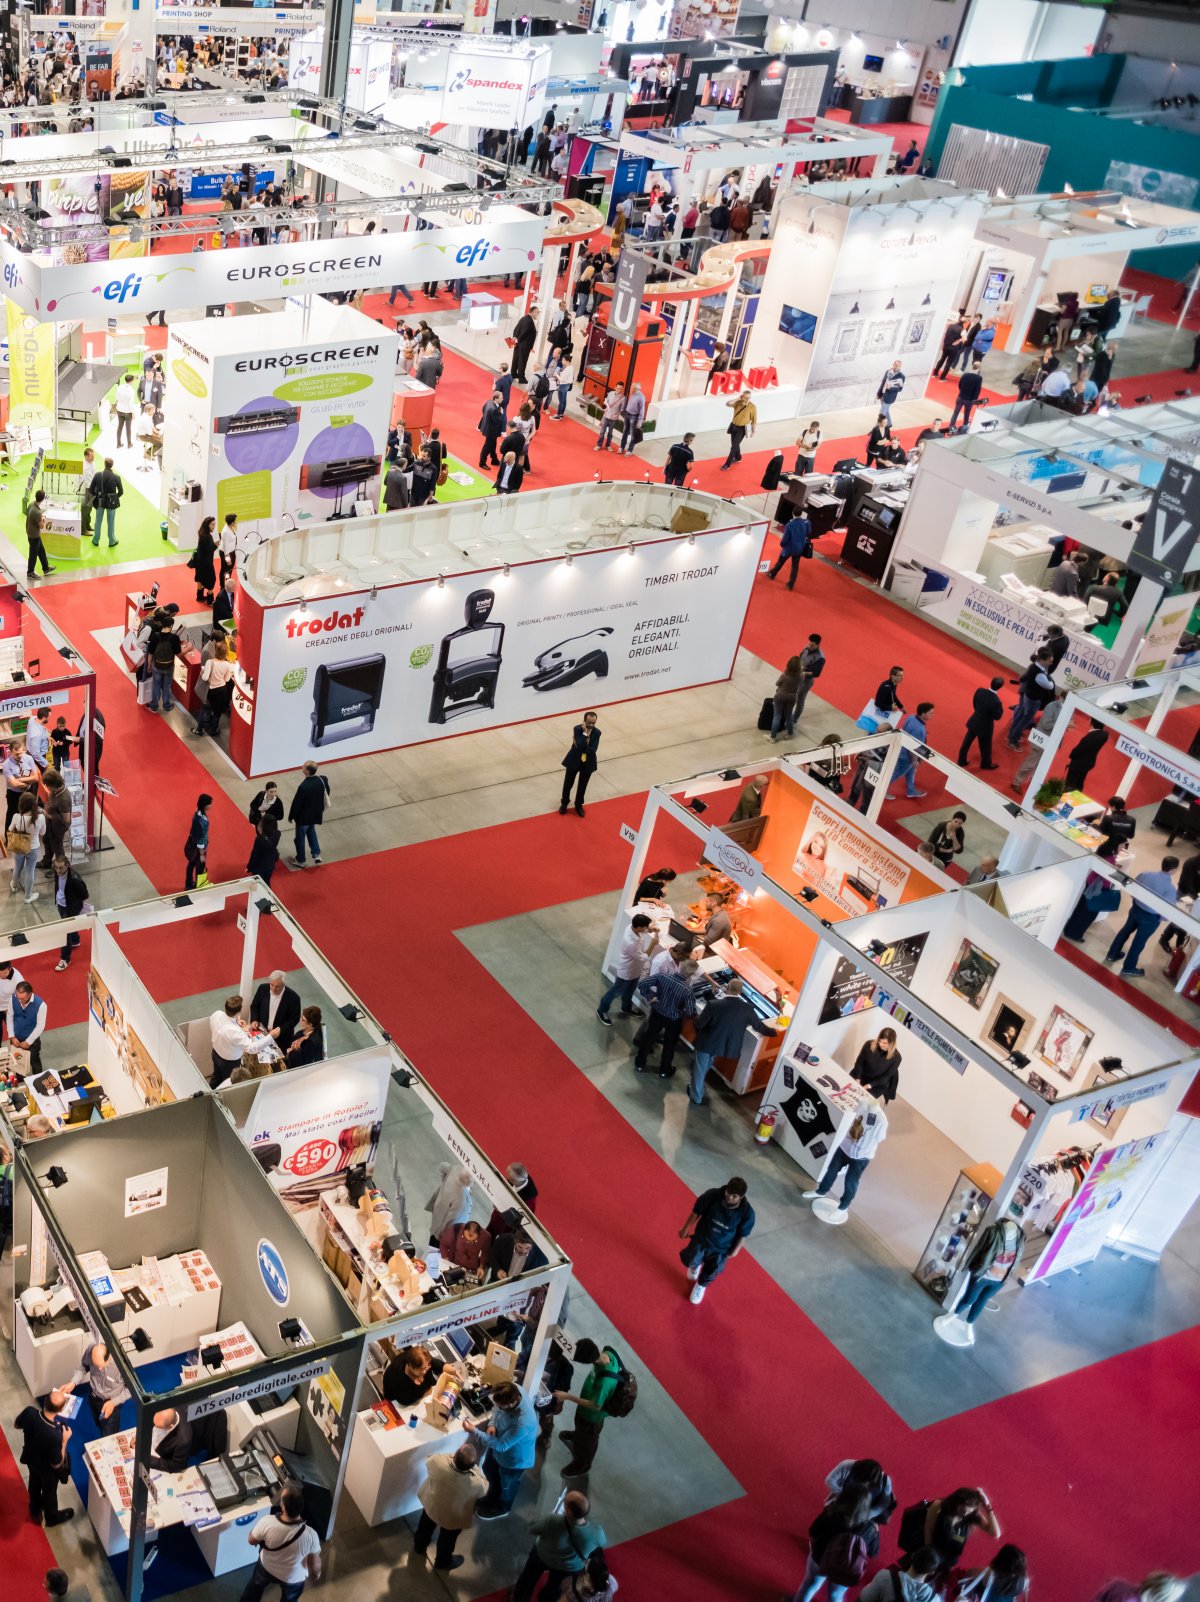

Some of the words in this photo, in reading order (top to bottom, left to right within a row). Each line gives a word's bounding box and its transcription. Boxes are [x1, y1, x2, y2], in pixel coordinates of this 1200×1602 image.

[69, 21, 96, 29] Roland
[209, 25, 237, 33] Roland
[308, 65, 361, 80] spex
[466, 77, 524, 92] spandex
[455, 238, 491, 266] efi
[4, 263, 19, 288] efi
[226, 254, 382, 282] EUROSCREEN
[103, 272, 143, 303] efi
[614, 292, 637, 331] U
[234, 344, 380, 373] EUROSCREEN
[710, 365, 780, 396] PENTA
[1181, 473, 1194, 496] 1
[1006, 490, 1037, 510] E-SERVIZI
[1152, 508, 1194, 562] V
[644, 571, 679, 588] TIMBRI
[681, 565, 720, 581] TRODAT
[285, 606, 364, 639] trodat
[516, 617, 542, 628] ORIGINAL
[543, 613, 562, 623] PRINTY
[566, 606, 605, 618] PROFESSIONAL
[610, 602, 624, 611] IDEAL
[625, 600, 639, 608] SEAL
[634, 613, 690, 632] AFFIDABILI.
[305, 634, 348, 648] CREAZIONE
[350, 629, 373, 641] DEGLI
[374, 622, 413, 637] ORIGINALI
[631, 628, 681, 646] ELEGANTI.
[968, 586, 1017, 618] XEROX
[1081, 645, 1117, 672] 2100
[972, 601, 1006, 626] ESCLUSIVA
[1087, 662, 1111, 683] ITALIA
[628, 641, 680, 659] ORIGINALI.
[623, 665, 672, 681] www.trodat.net
[341, 702, 364, 714] trodat
[1031, 731, 1045, 745] V15
[1119, 739, 1182, 780] TECNOTRONICA
[868, 771, 880, 784] V17
[812, 805, 840, 831] Scopri
[623, 827, 636, 842] V19
[712, 840, 756, 878] LASERGOLD
[915, 1019, 935, 1042] TEXTILE
[934, 1033, 955, 1057] PIGMENT
[954, 1051, 965, 1065] INK
[277, 1115, 320, 1133] Stampare
[333, 1101, 369, 1117] Rotolo?
[284, 1130, 300, 1140] Mai
[302, 1123, 325, 1135] stato
[348, 1106, 378, 1122] Facile!
[446, 1132, 472, 1166] FENIX
[1023, 1170, 1043, 1190] Z20
[259, 1251, 288, 1297] ATS
[427, 1304, 500, 1336] PIPPONLINE
[556, 1332, 574, 1354] Z22
[194, 1400, 216, 1416] ATS
[217, 1365, 325, 1411] coloredigitale.com
